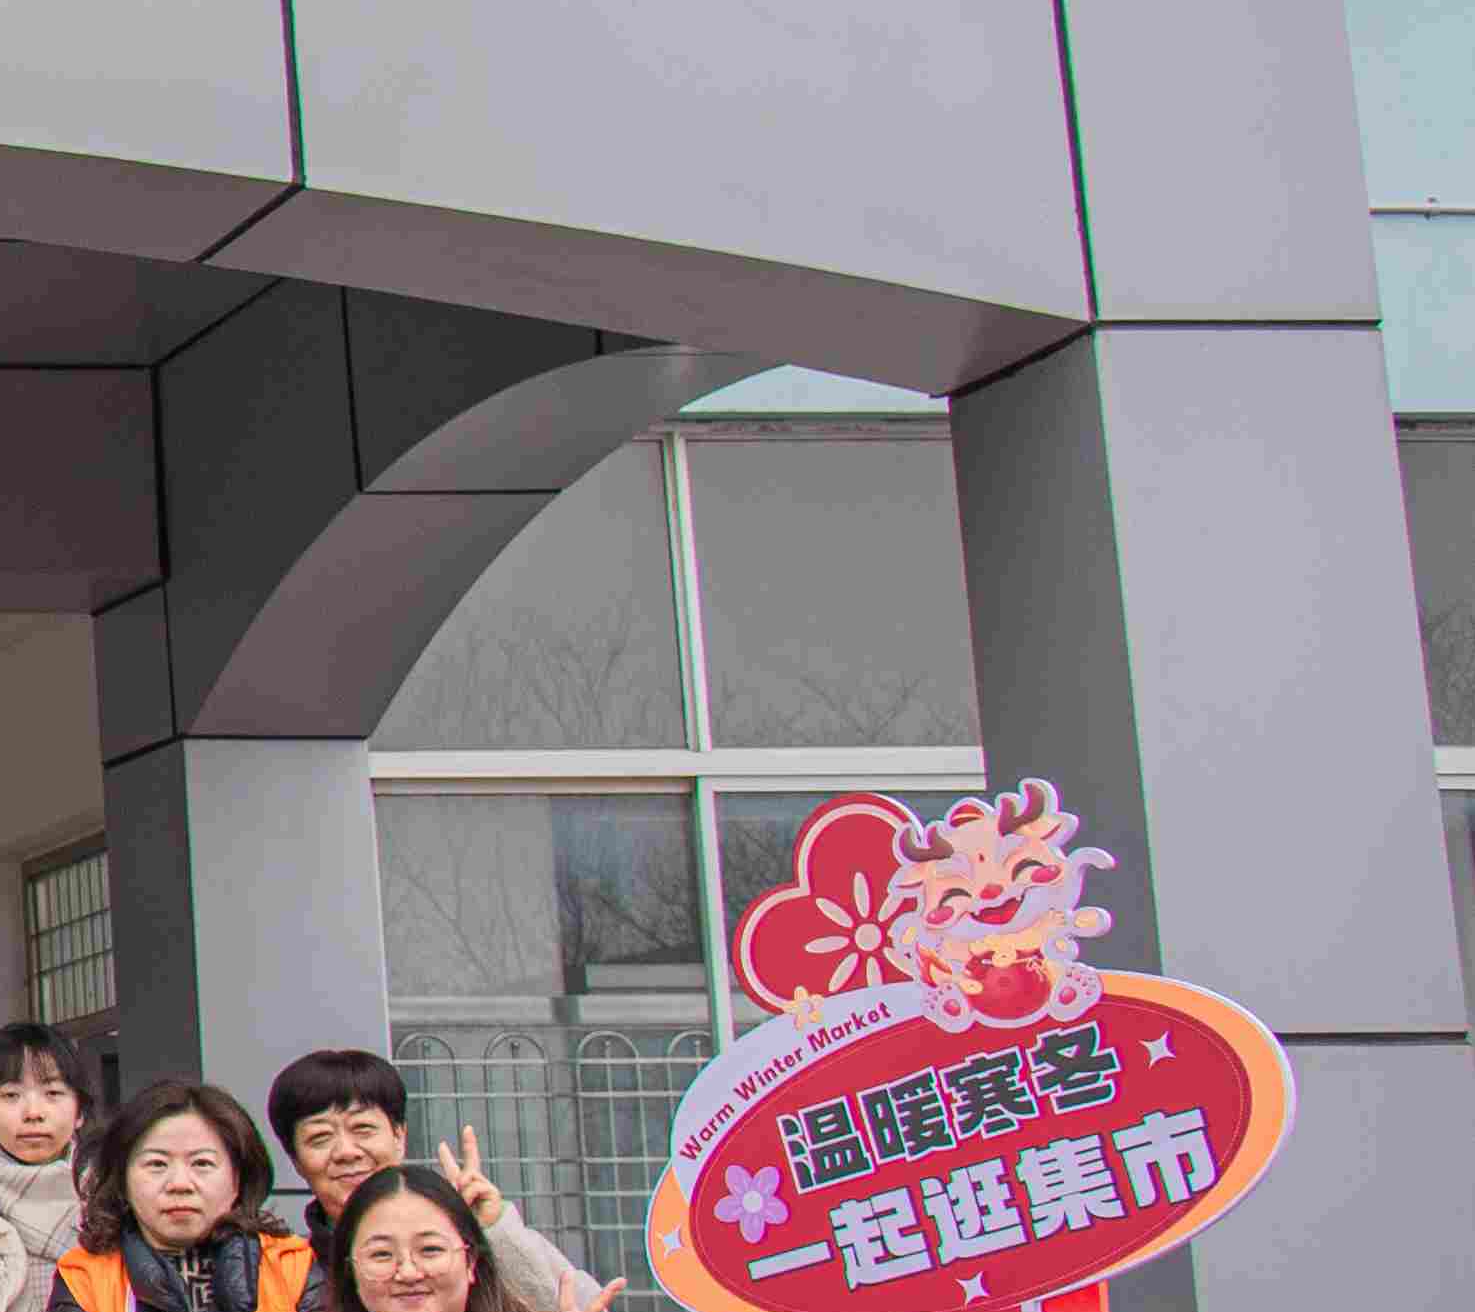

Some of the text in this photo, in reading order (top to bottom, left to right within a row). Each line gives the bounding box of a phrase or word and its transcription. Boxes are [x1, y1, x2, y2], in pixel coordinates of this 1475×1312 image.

[679, 1001, 892, 1162] Warm Winter Market
[777, 1020, 1123, 1195] 温暖寒冬
[748, 1107, 1221, 1290] 一起逛集市
